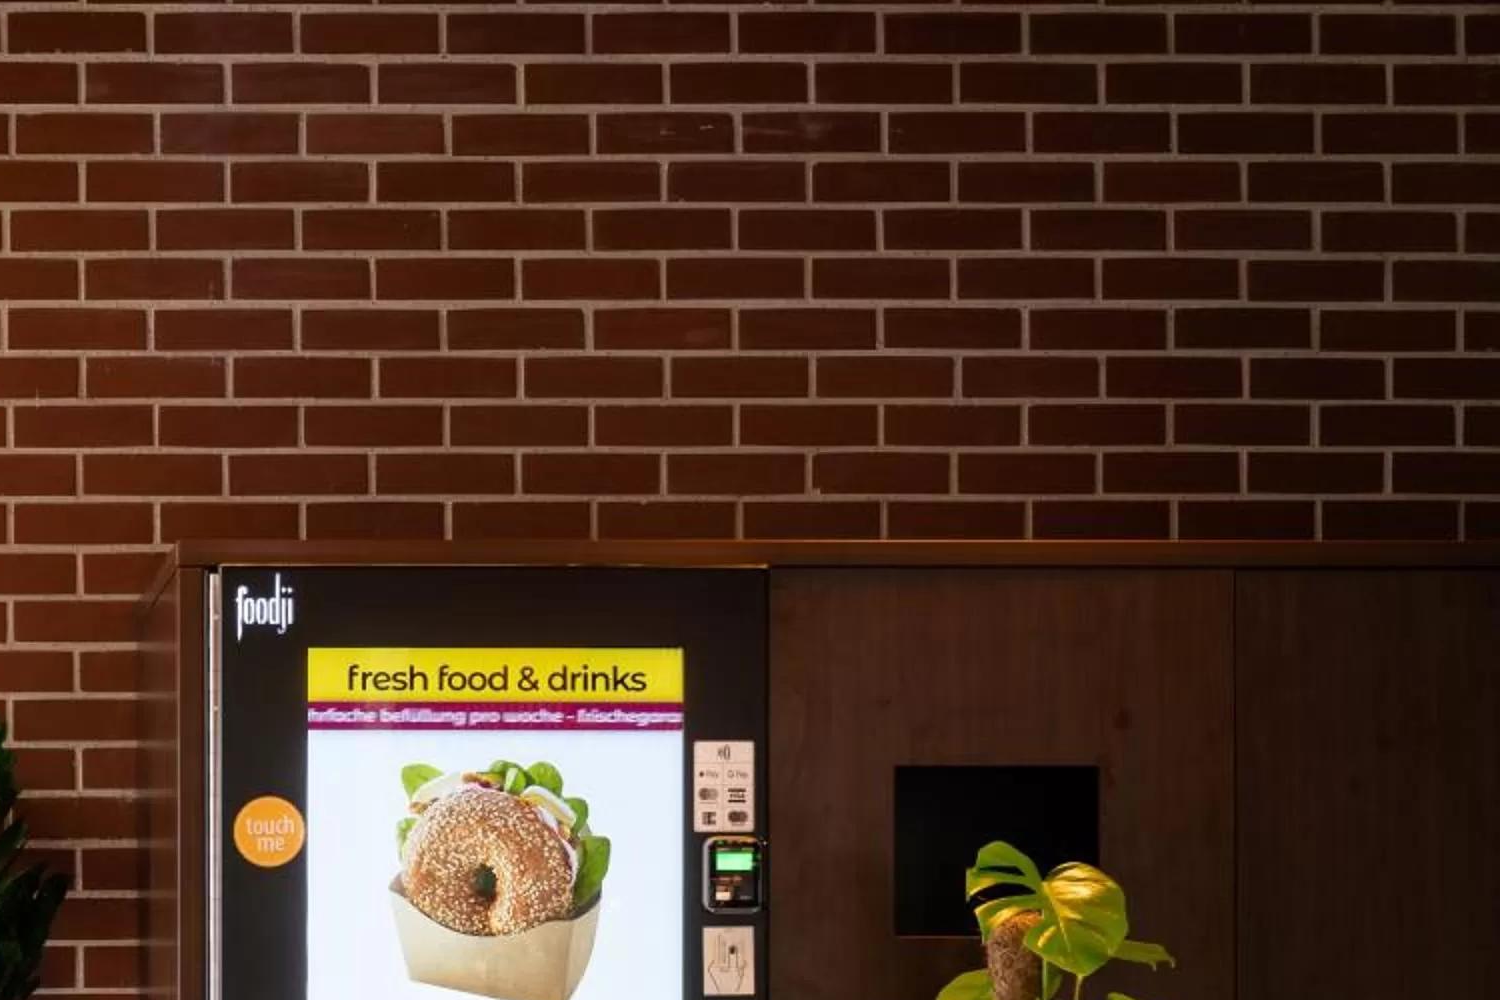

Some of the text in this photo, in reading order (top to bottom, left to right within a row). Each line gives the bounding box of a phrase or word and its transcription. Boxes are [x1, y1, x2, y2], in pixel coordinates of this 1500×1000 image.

[236, 572, 294, 641] foodji
[348, 664, 647, 692] fresh food & drinks
[245, 815, 295, 834] touch
[257, 837, 285, 852] me
